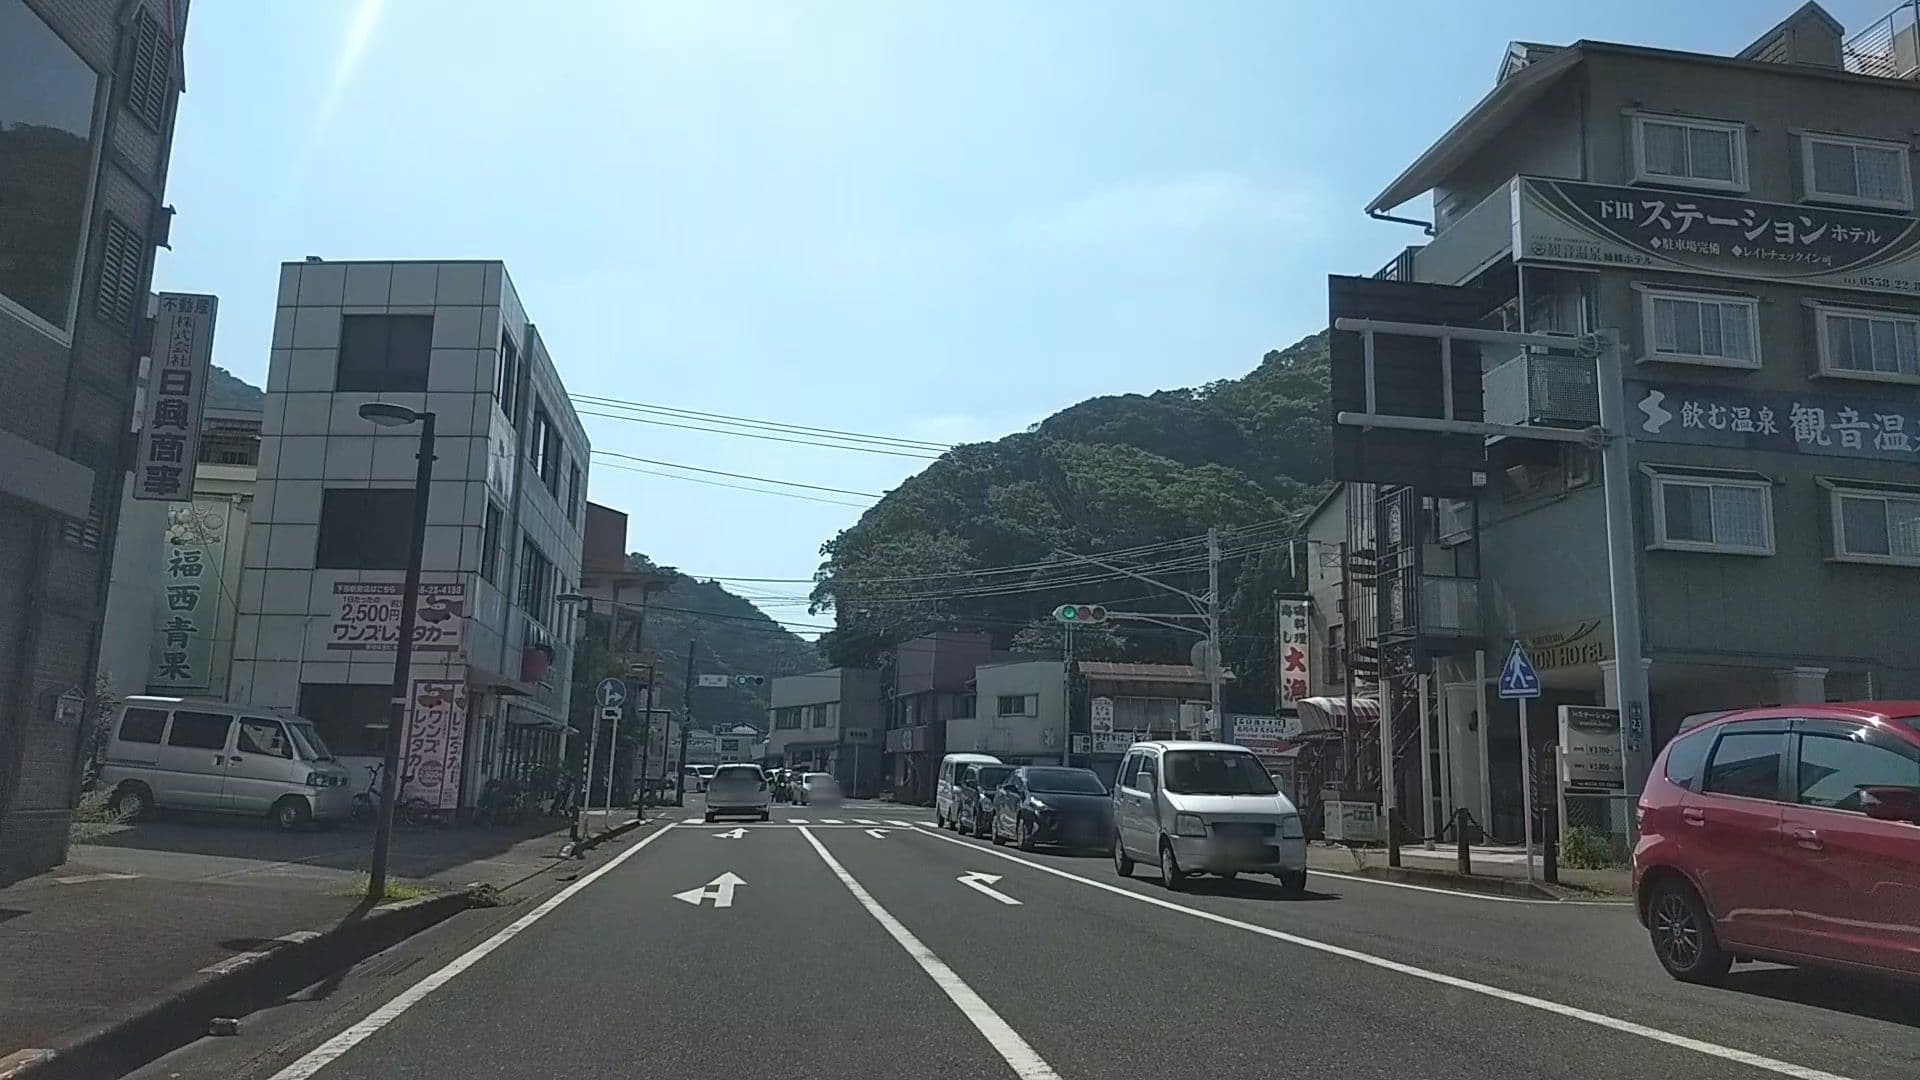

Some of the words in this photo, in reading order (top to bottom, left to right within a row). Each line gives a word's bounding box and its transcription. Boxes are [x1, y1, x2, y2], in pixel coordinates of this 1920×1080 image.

[1595, 200, 1635, 219] 下田
[1639, 199, 1828, 245] ステーション
[1831, 225, 1881, 244] ホテル
[163, 297, 209, 315] 不動産
[144, 369, 193, 495] 日興商事
[1680, 401, 1779, 435] 飲む温泉
[1789, 402, 1920, 452] 観音温
[158, 549, 204, 680] 福西青果
[341, 603, 400, 622] 2,500円
[1560, 642, 1607, 666] HOTEL
[424, 710, 443, 753] ワンズ
